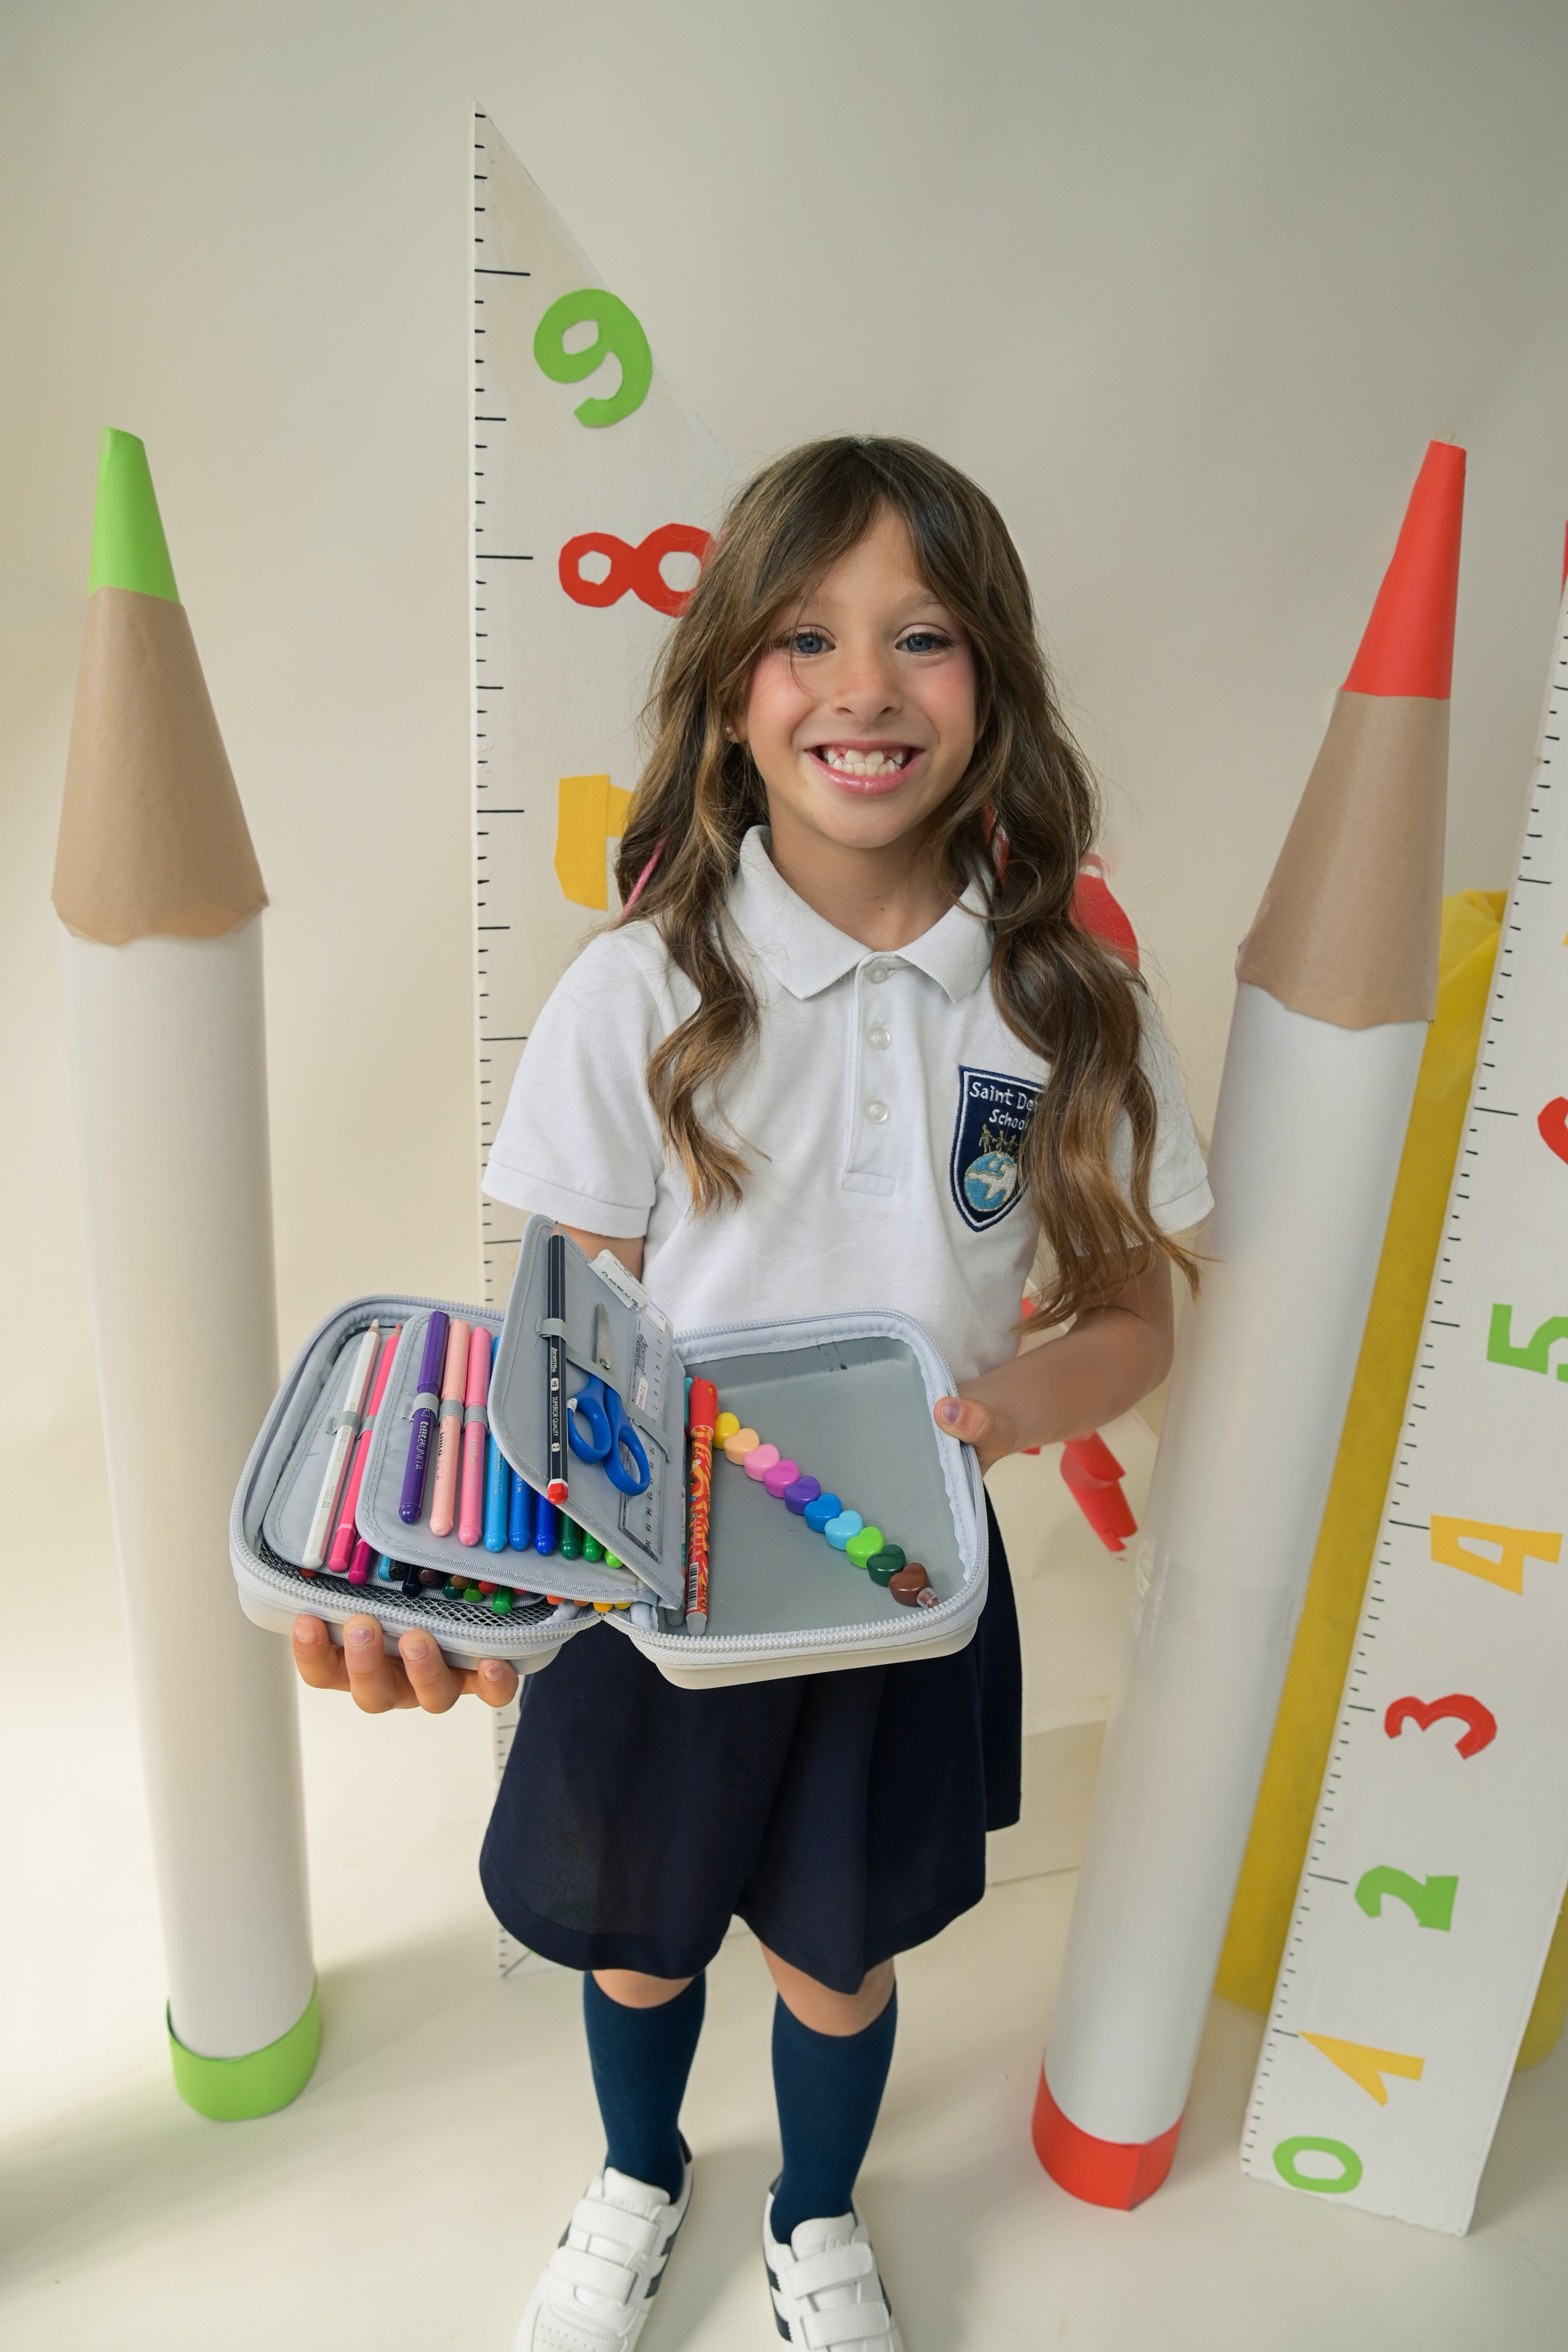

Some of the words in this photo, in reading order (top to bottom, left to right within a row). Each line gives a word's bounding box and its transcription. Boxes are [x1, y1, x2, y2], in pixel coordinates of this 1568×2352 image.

[534, 289, 652, 427] 9
[559, 523, 716, 618] 8
[970, 1082, 1014, 1106] Saint
[1016, 1092, 1037, 1111] De
[1487, 1303, 1568, 1383] 5
[649, 1461, 654, 1469] 11
[650, 1446, 655, 1455] 10
[646, 1507, 652, 1517] 14
[647, 1491, 653, 1501] 13
[645, 1523, 652, 1533] 15
[1430, 1515, 1562, 1595] 4
[1384, 1694, 1497, 1759] 3
[1355, 1866, 1459, 1931] 2
[1297, 2031, 1425, 2106] 1
[1273, 2136, 1363, 2193] 0
